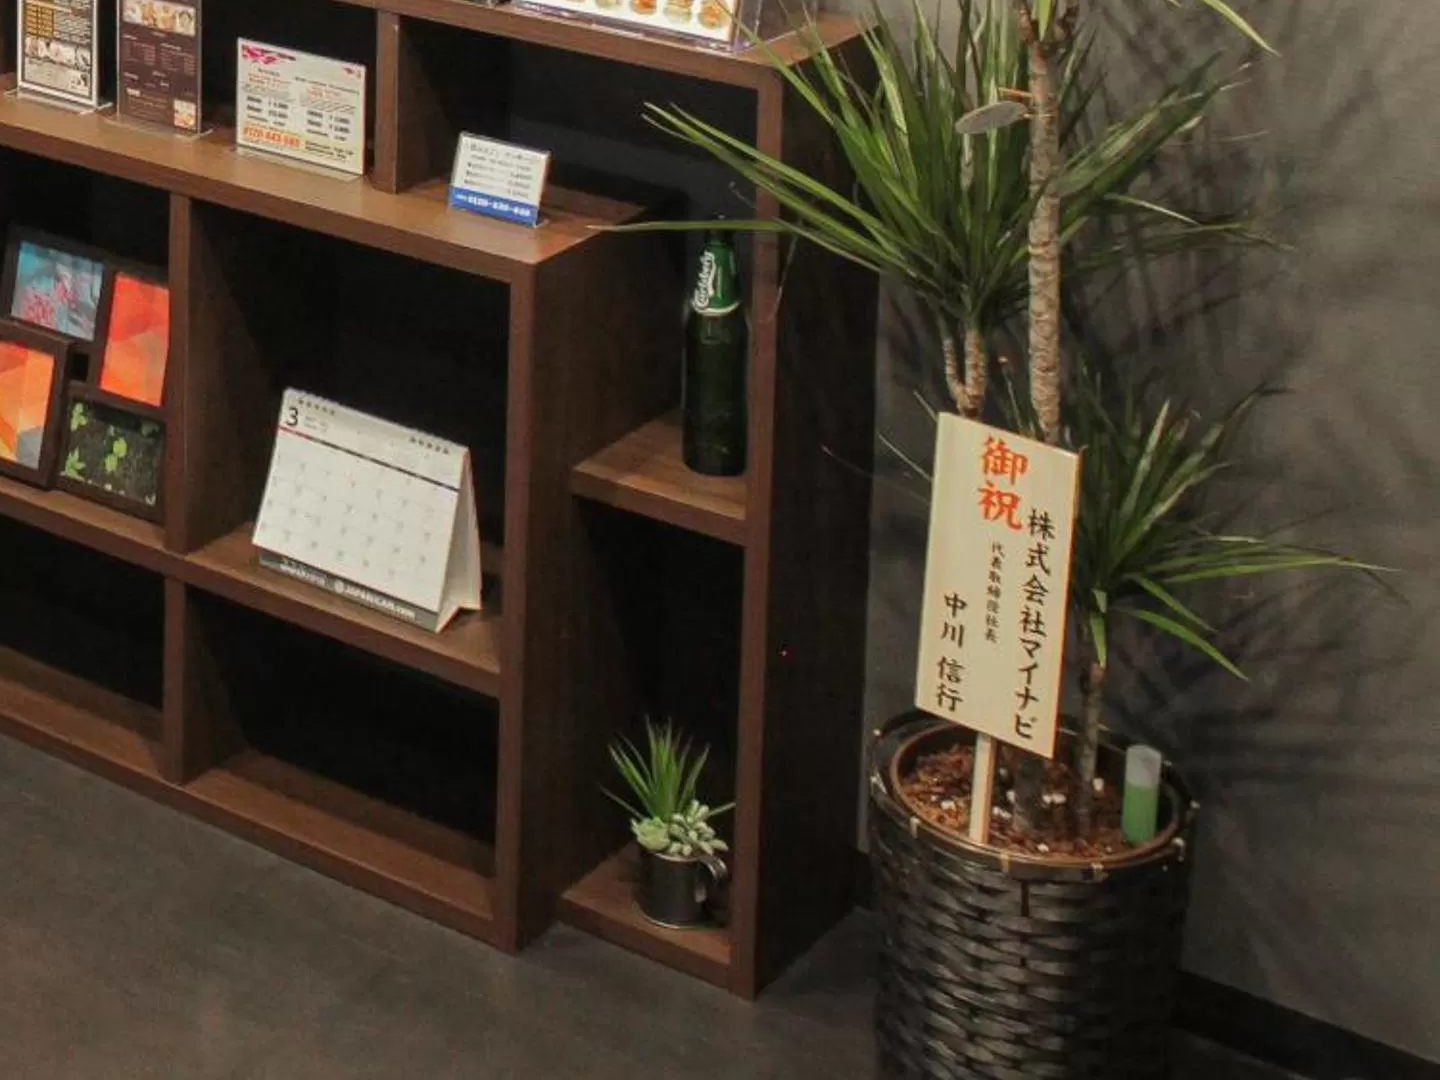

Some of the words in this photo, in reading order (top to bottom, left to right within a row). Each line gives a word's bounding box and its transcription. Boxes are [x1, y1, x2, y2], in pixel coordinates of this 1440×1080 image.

[286, 406, 300, 427] 3
[977, 436, 1028, 531] 御祝
[1014, 508, 1056, 740] 株式会社マイナビ
